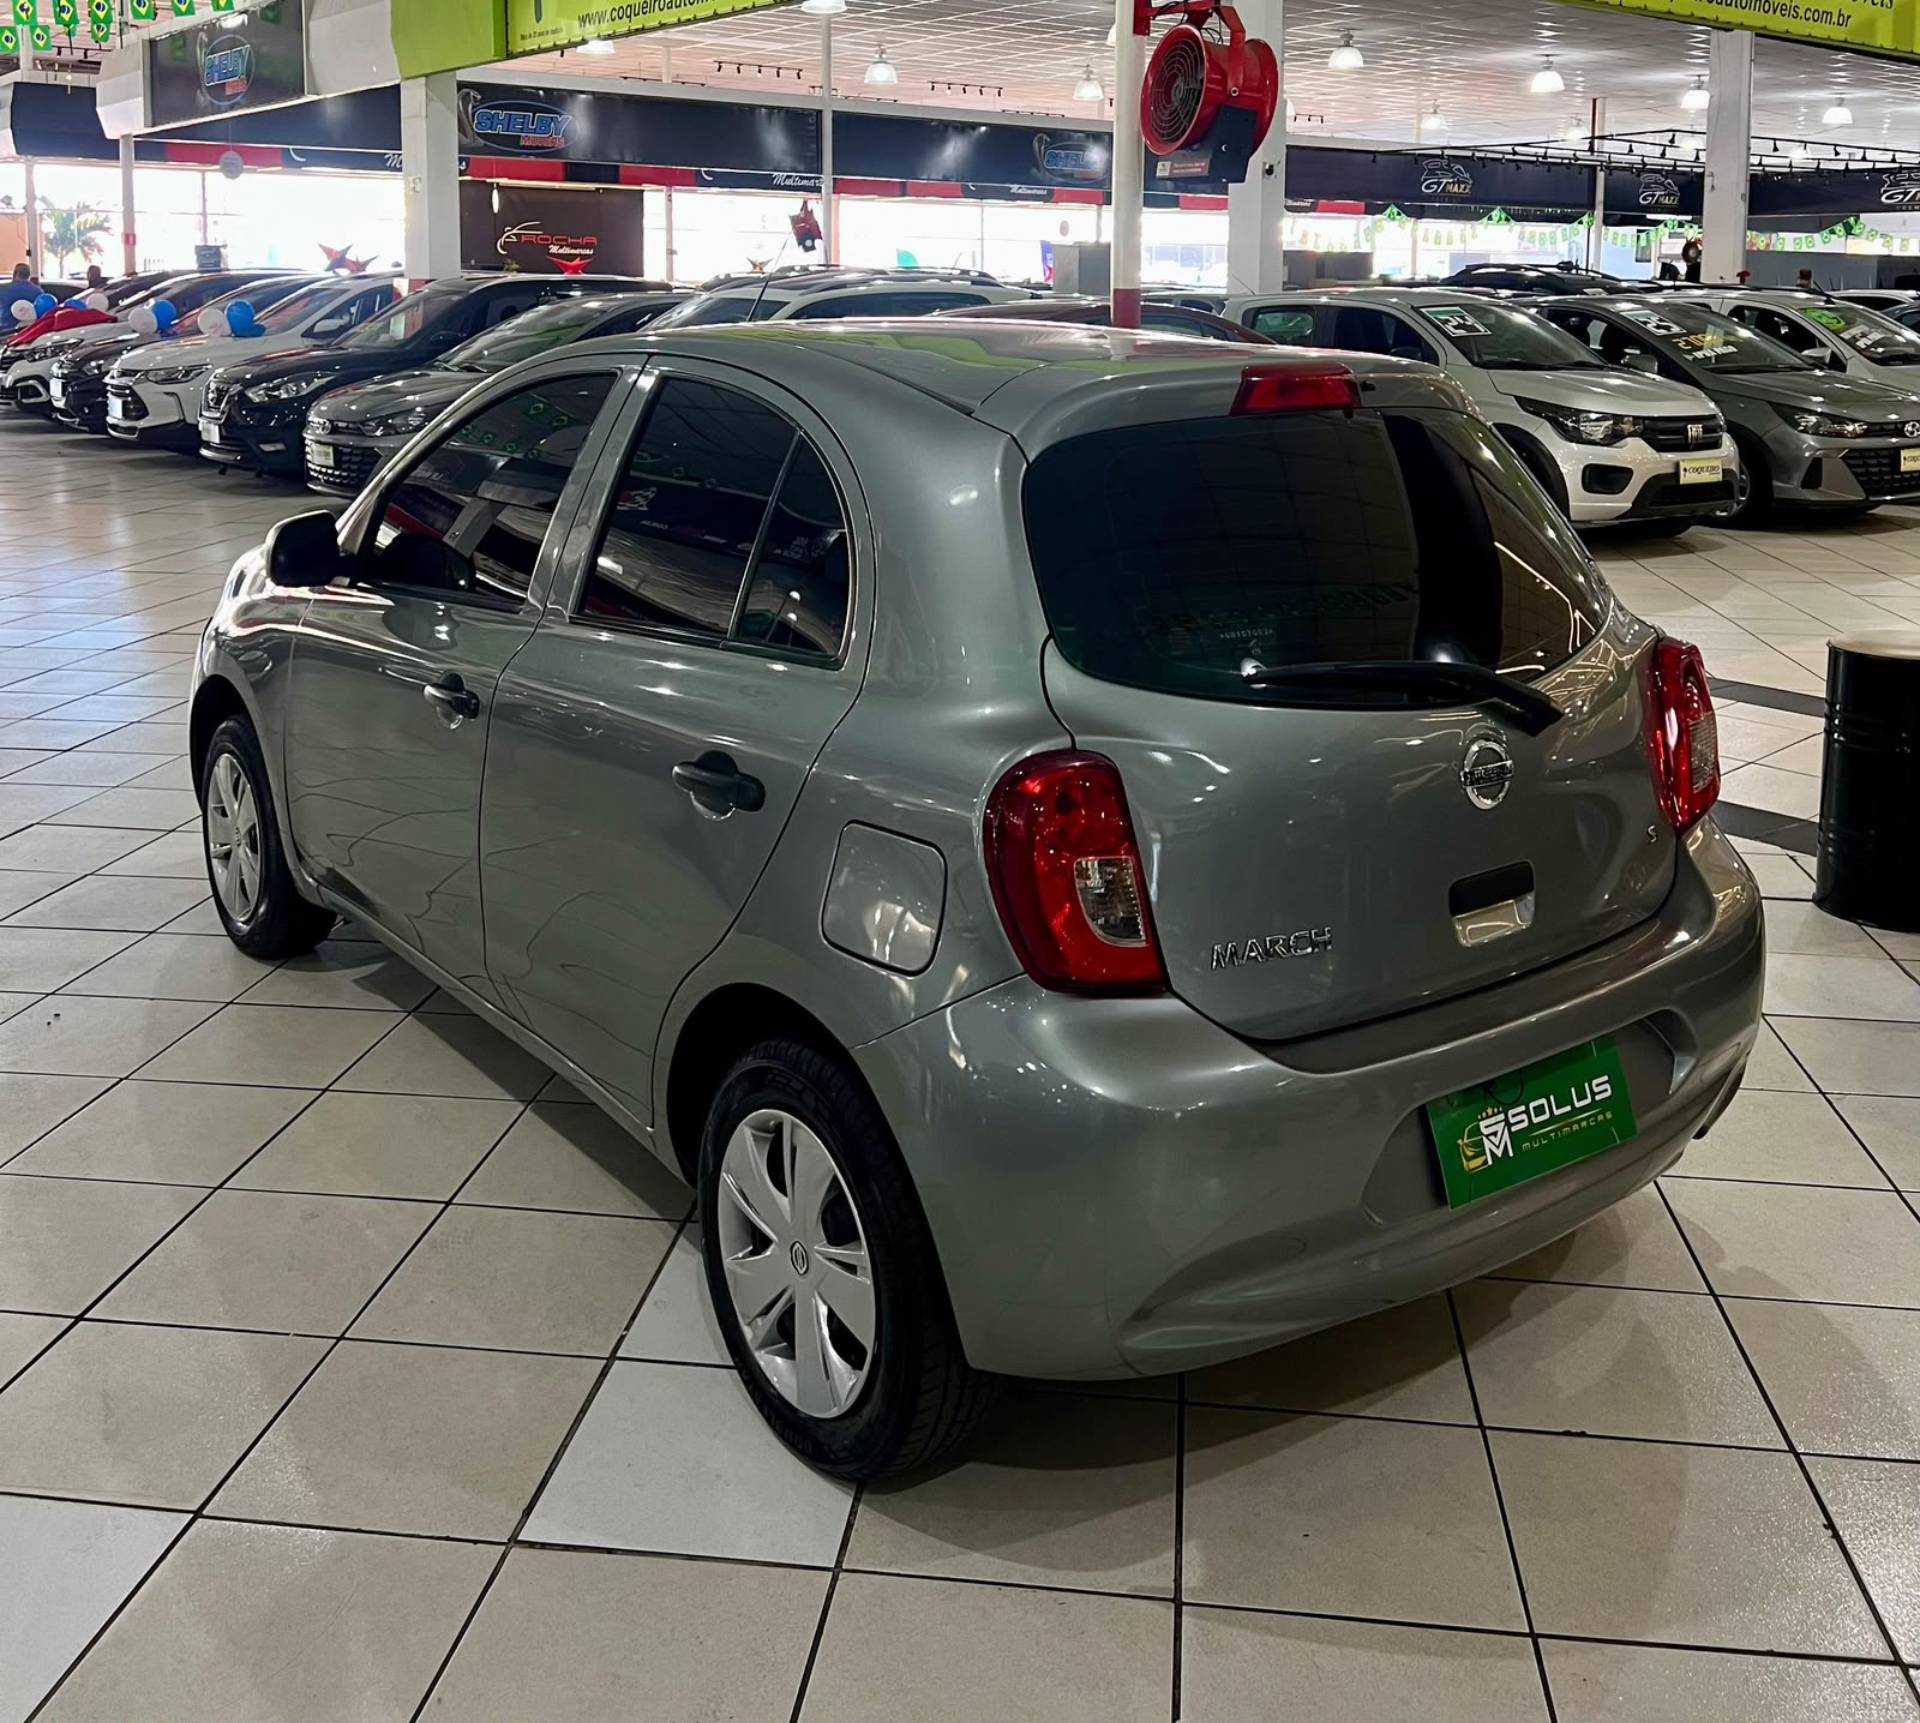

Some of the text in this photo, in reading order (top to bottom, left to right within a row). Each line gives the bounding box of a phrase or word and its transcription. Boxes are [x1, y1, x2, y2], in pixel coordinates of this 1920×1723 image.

[473, 109, 572, 138] SHELBY
[520, 234, 598, 246] ROCHA
[1211, 927, 1332, 969] MARCH
[1507, 1074, 1613, 1133] SOLUS
[1521, 1110, 1613, 1152] MULTIMARCAS
